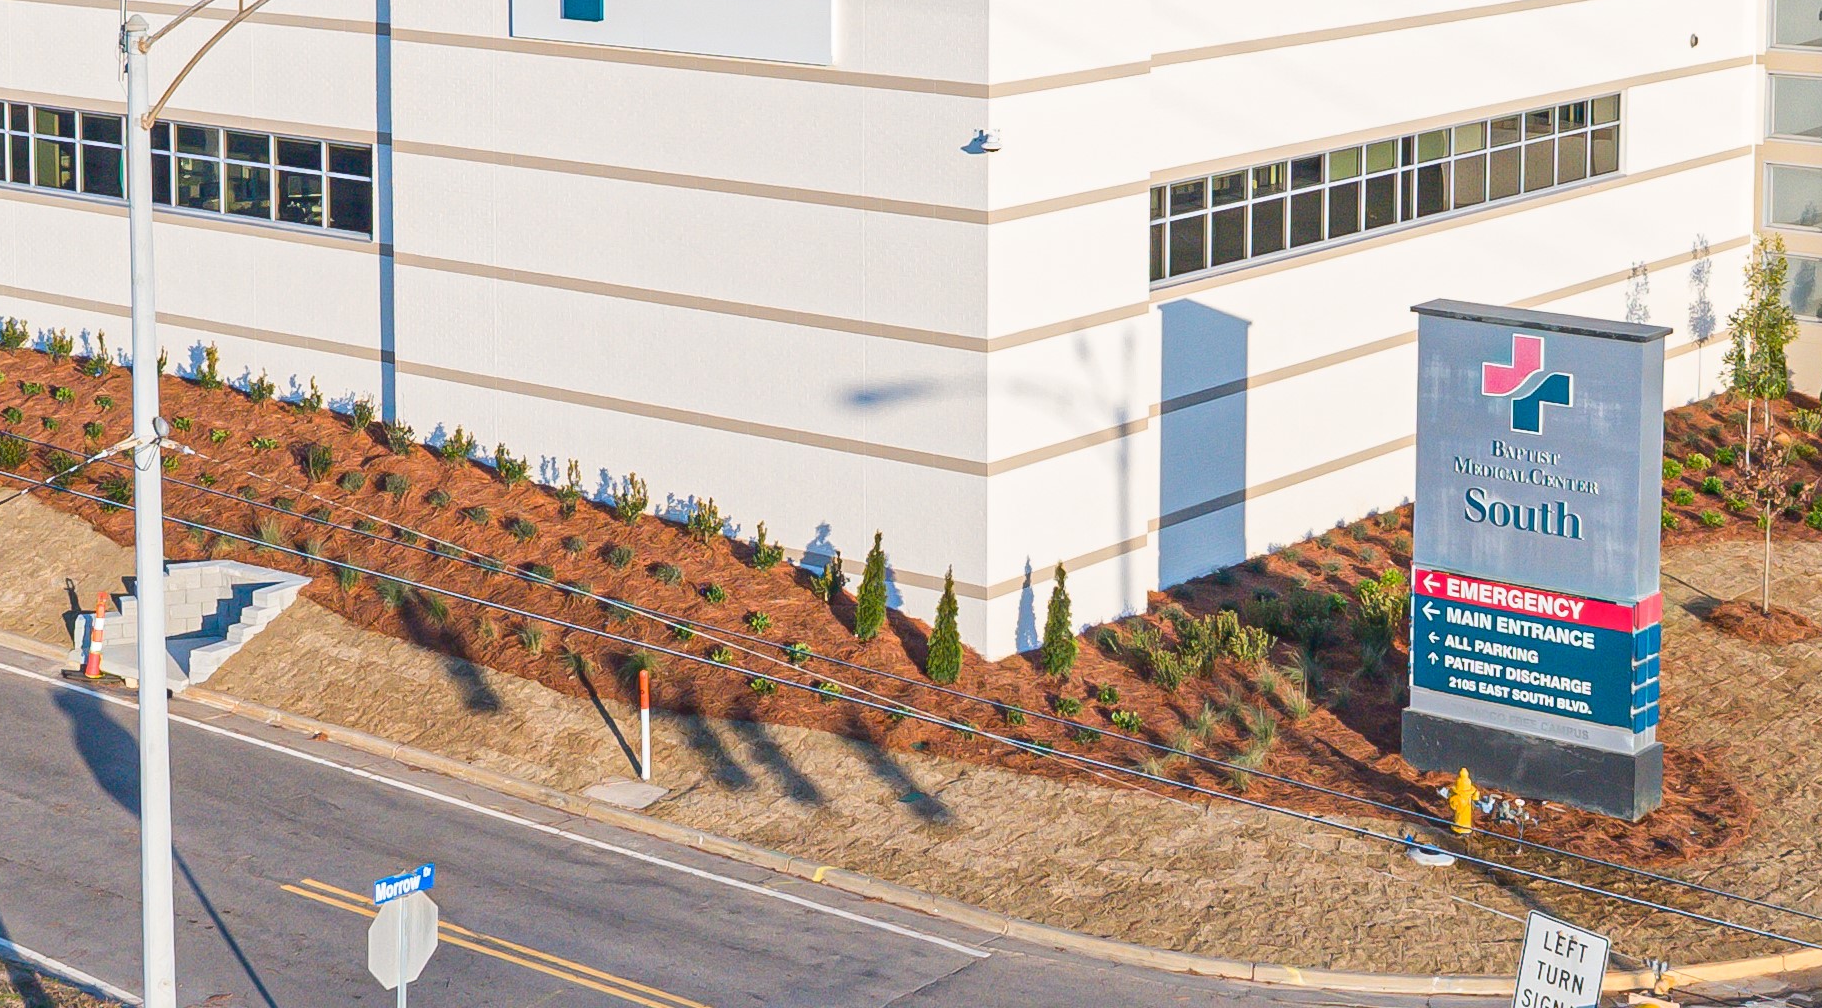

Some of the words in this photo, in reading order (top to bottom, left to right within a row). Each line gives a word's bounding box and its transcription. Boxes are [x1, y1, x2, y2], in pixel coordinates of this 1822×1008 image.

[1491, 440, 1561, 465] BAPTIST
[1454, 455, 1528, 484] MEDICAL
[1529, 468, 1599, 495] CENTER
[1464, 487, 1584, 541] South
[1446, 578, 1584, 620] EMERGENCY
[1446, 607, 1492, 631] MAIN
[1496, 616, 1595, 650] ENTRANCE
[1444, 634, 1471, 652] ALL
[1474, 639, 1539, 664] PARKING
[1444, 654, 1503, 678] PATIENT
[1505, 666, 1592, 695] DISCHARGE
[1448, 676, 1476, 692] 2105
[1479, 682, 1510, 699] EAST
[1511, 688, 1554, 708] SOUTH
[1556, 697, 1593, 715] BLVD.
[375, 875, 421, 902] Morrow
[423, 866, 432, 877] Dr
[1544, 930, 1589, 963] LEFT
[1538, 960, 1584, 996] TURN
